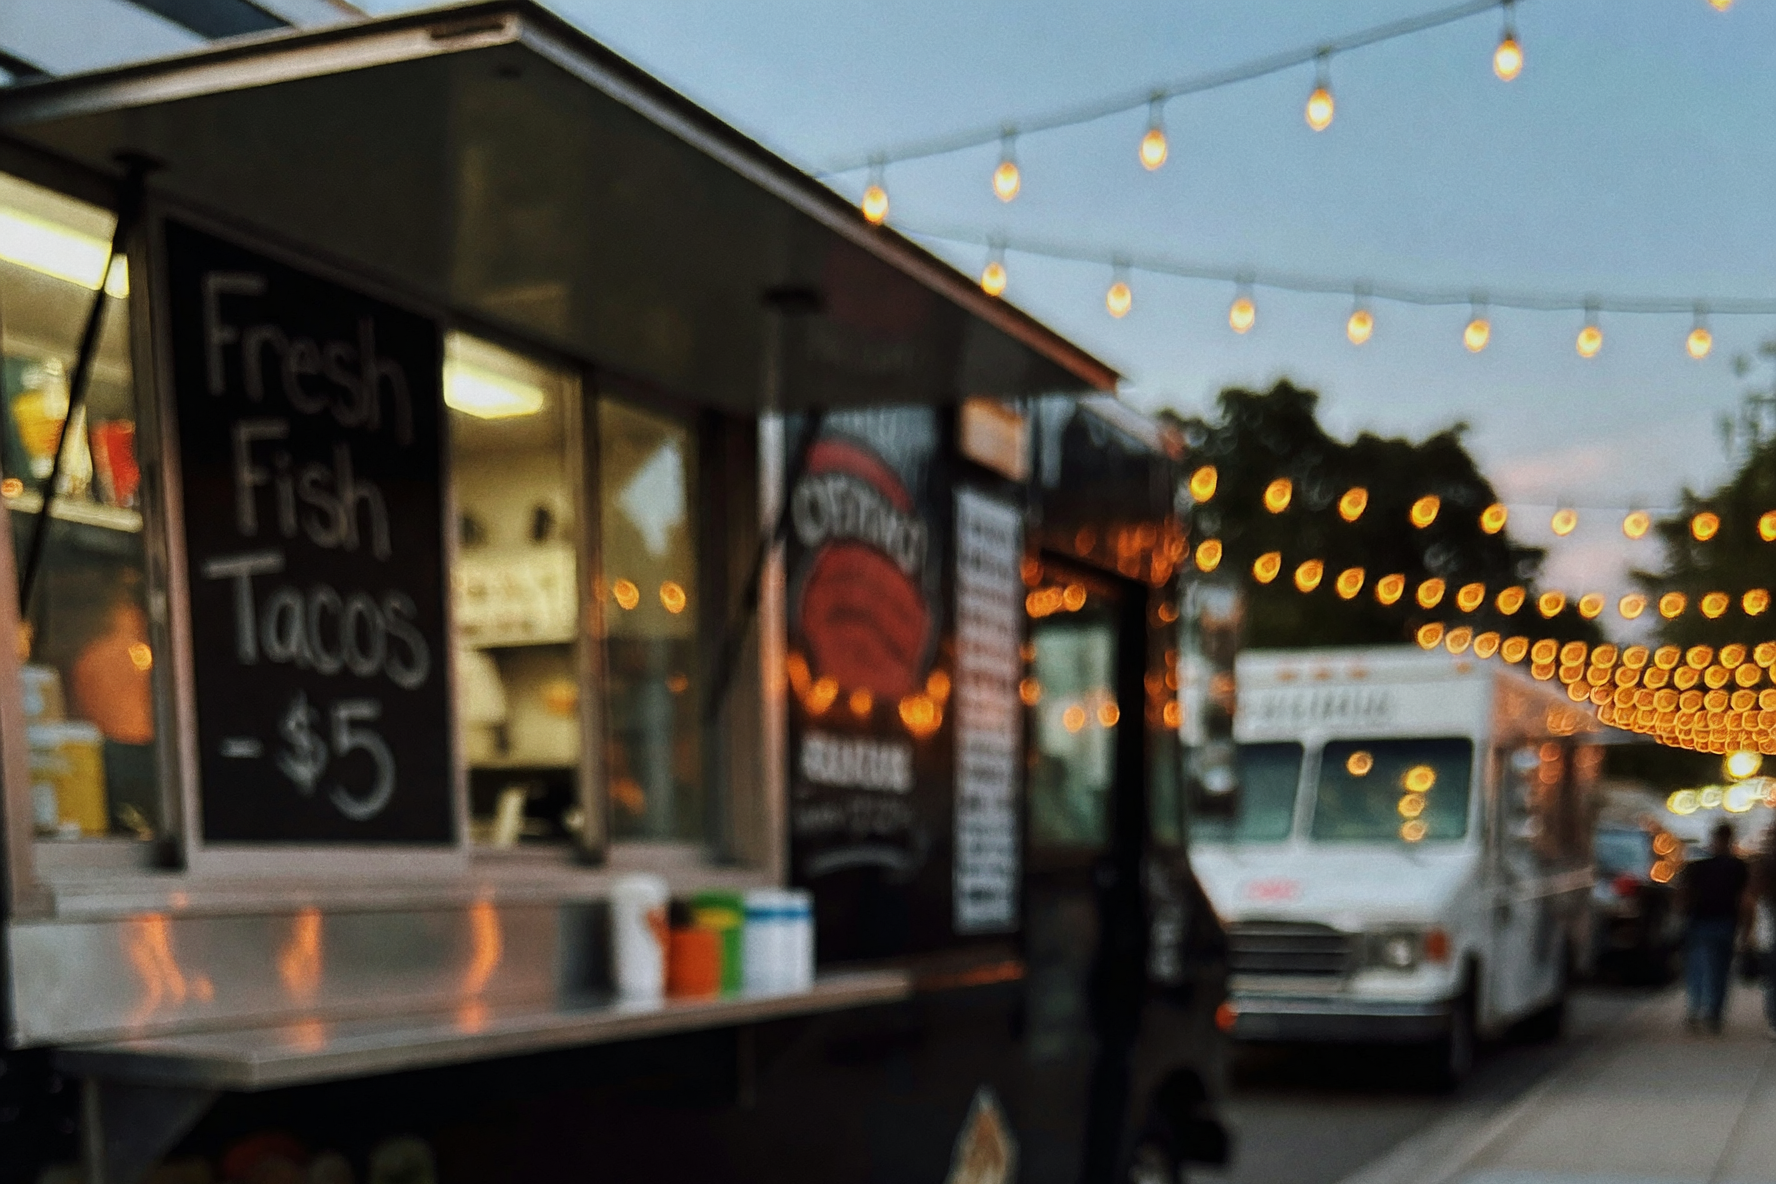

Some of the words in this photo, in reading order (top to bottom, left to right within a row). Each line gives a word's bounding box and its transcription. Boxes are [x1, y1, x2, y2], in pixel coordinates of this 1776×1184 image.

[202, 271, 413, 444] Fresh
[232, 417, 392, 561] Fish
[203, 549, 430, 689] Tacos
[276, 690, 396, 821] $5
